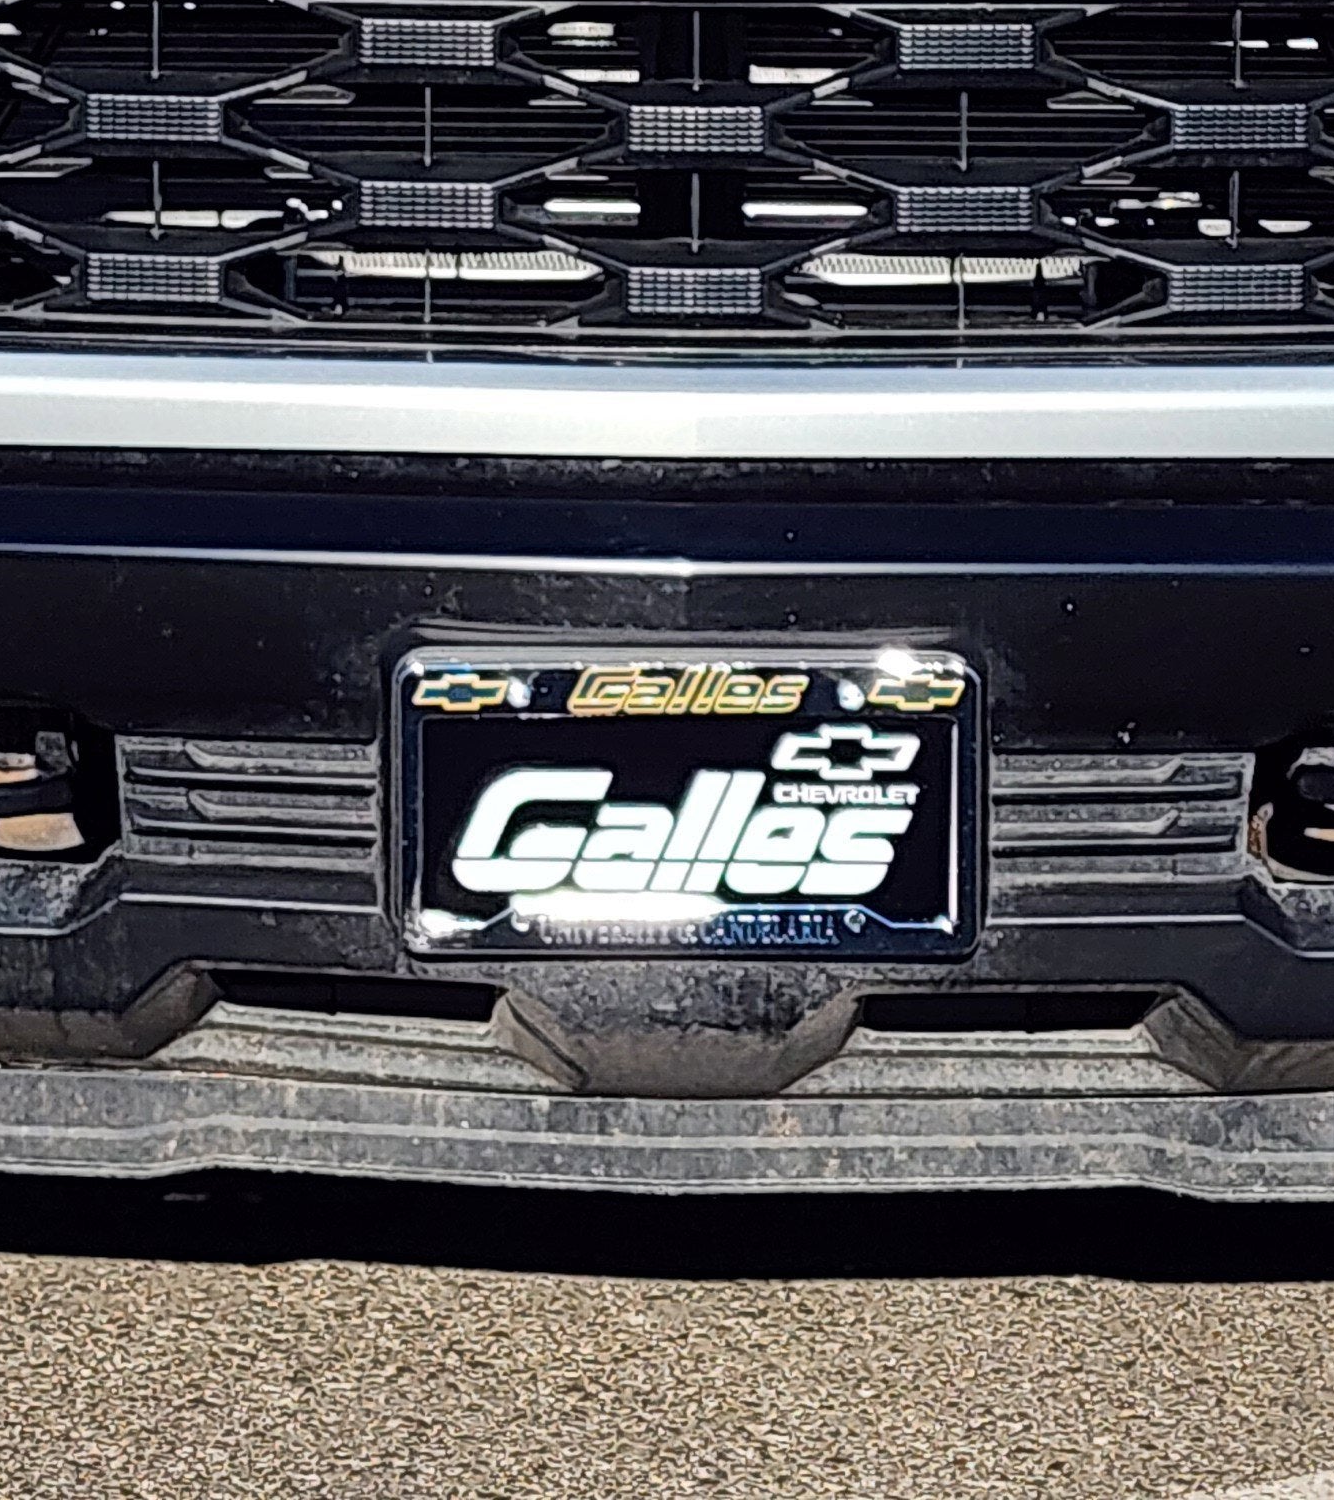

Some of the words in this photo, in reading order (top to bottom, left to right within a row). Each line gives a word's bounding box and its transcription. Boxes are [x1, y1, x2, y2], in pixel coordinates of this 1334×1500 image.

[566, 665, 811, 717] Galles
[772, 783, 921, 805] CHEVROLET
[451, 767, 914, 896] Galles
